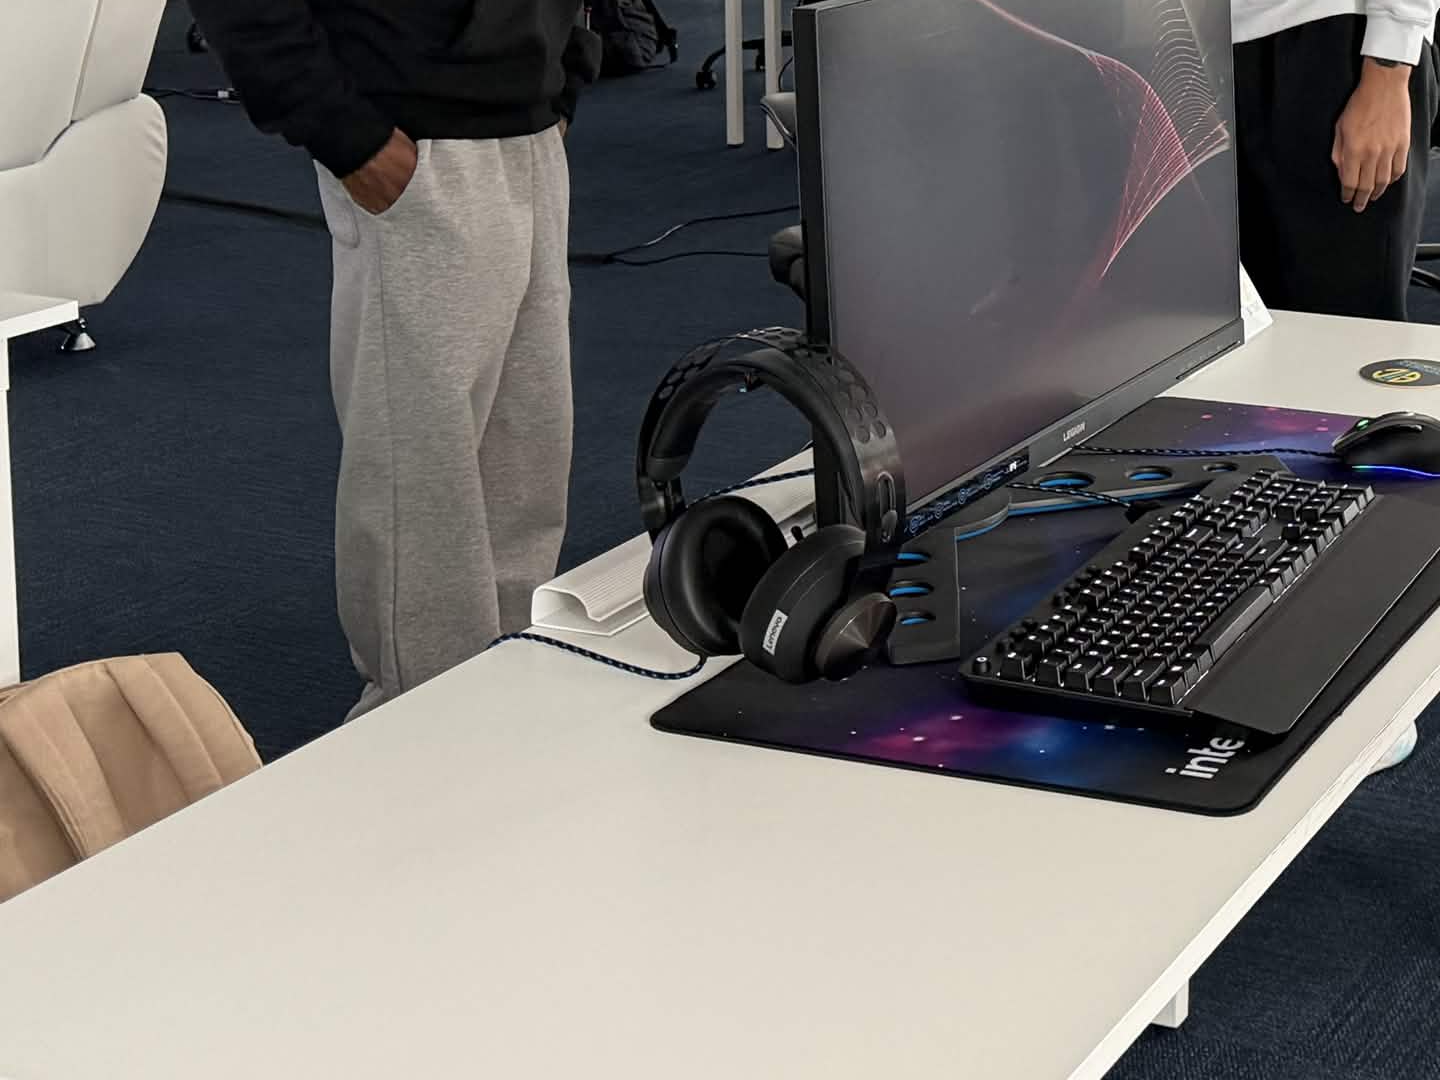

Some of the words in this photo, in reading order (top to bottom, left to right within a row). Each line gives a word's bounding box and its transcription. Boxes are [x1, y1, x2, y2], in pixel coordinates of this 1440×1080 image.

[1063, 422, 1086, 442] LEGION
[766, 616, 783, 650] Lenovo
[1165, 737, 1245, 779] inte
